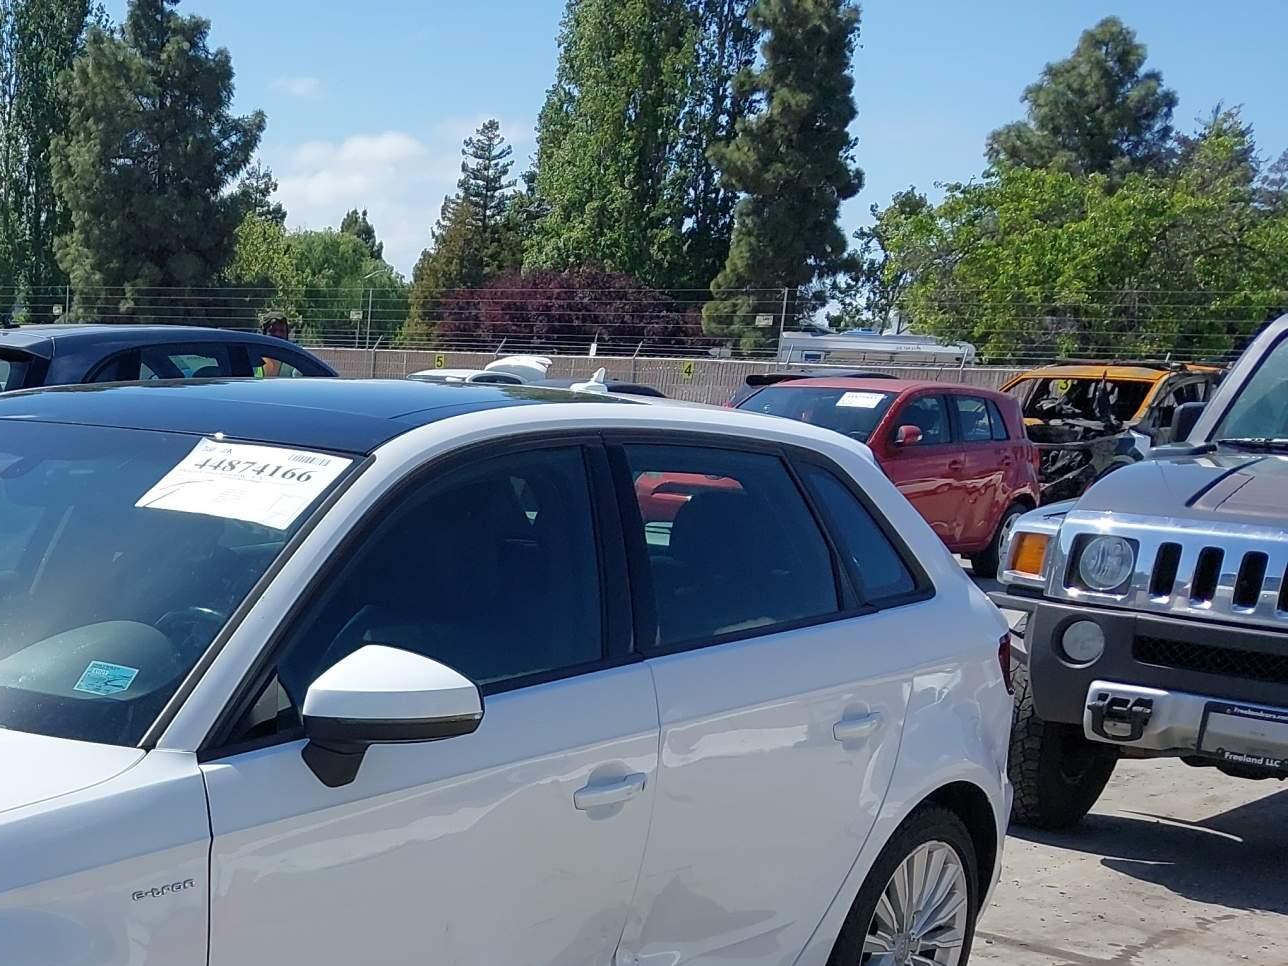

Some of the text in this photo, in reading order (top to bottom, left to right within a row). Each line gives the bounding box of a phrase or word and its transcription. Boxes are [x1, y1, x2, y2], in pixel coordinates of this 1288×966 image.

[436, 355, 443, 368] 5
[684, 363, 692, 377] 4
[194, 456, 318, 483] 44874166
[1224, 751, 1281, 768] Freeland LLC
[132, 878, 196, 901] e-tron
